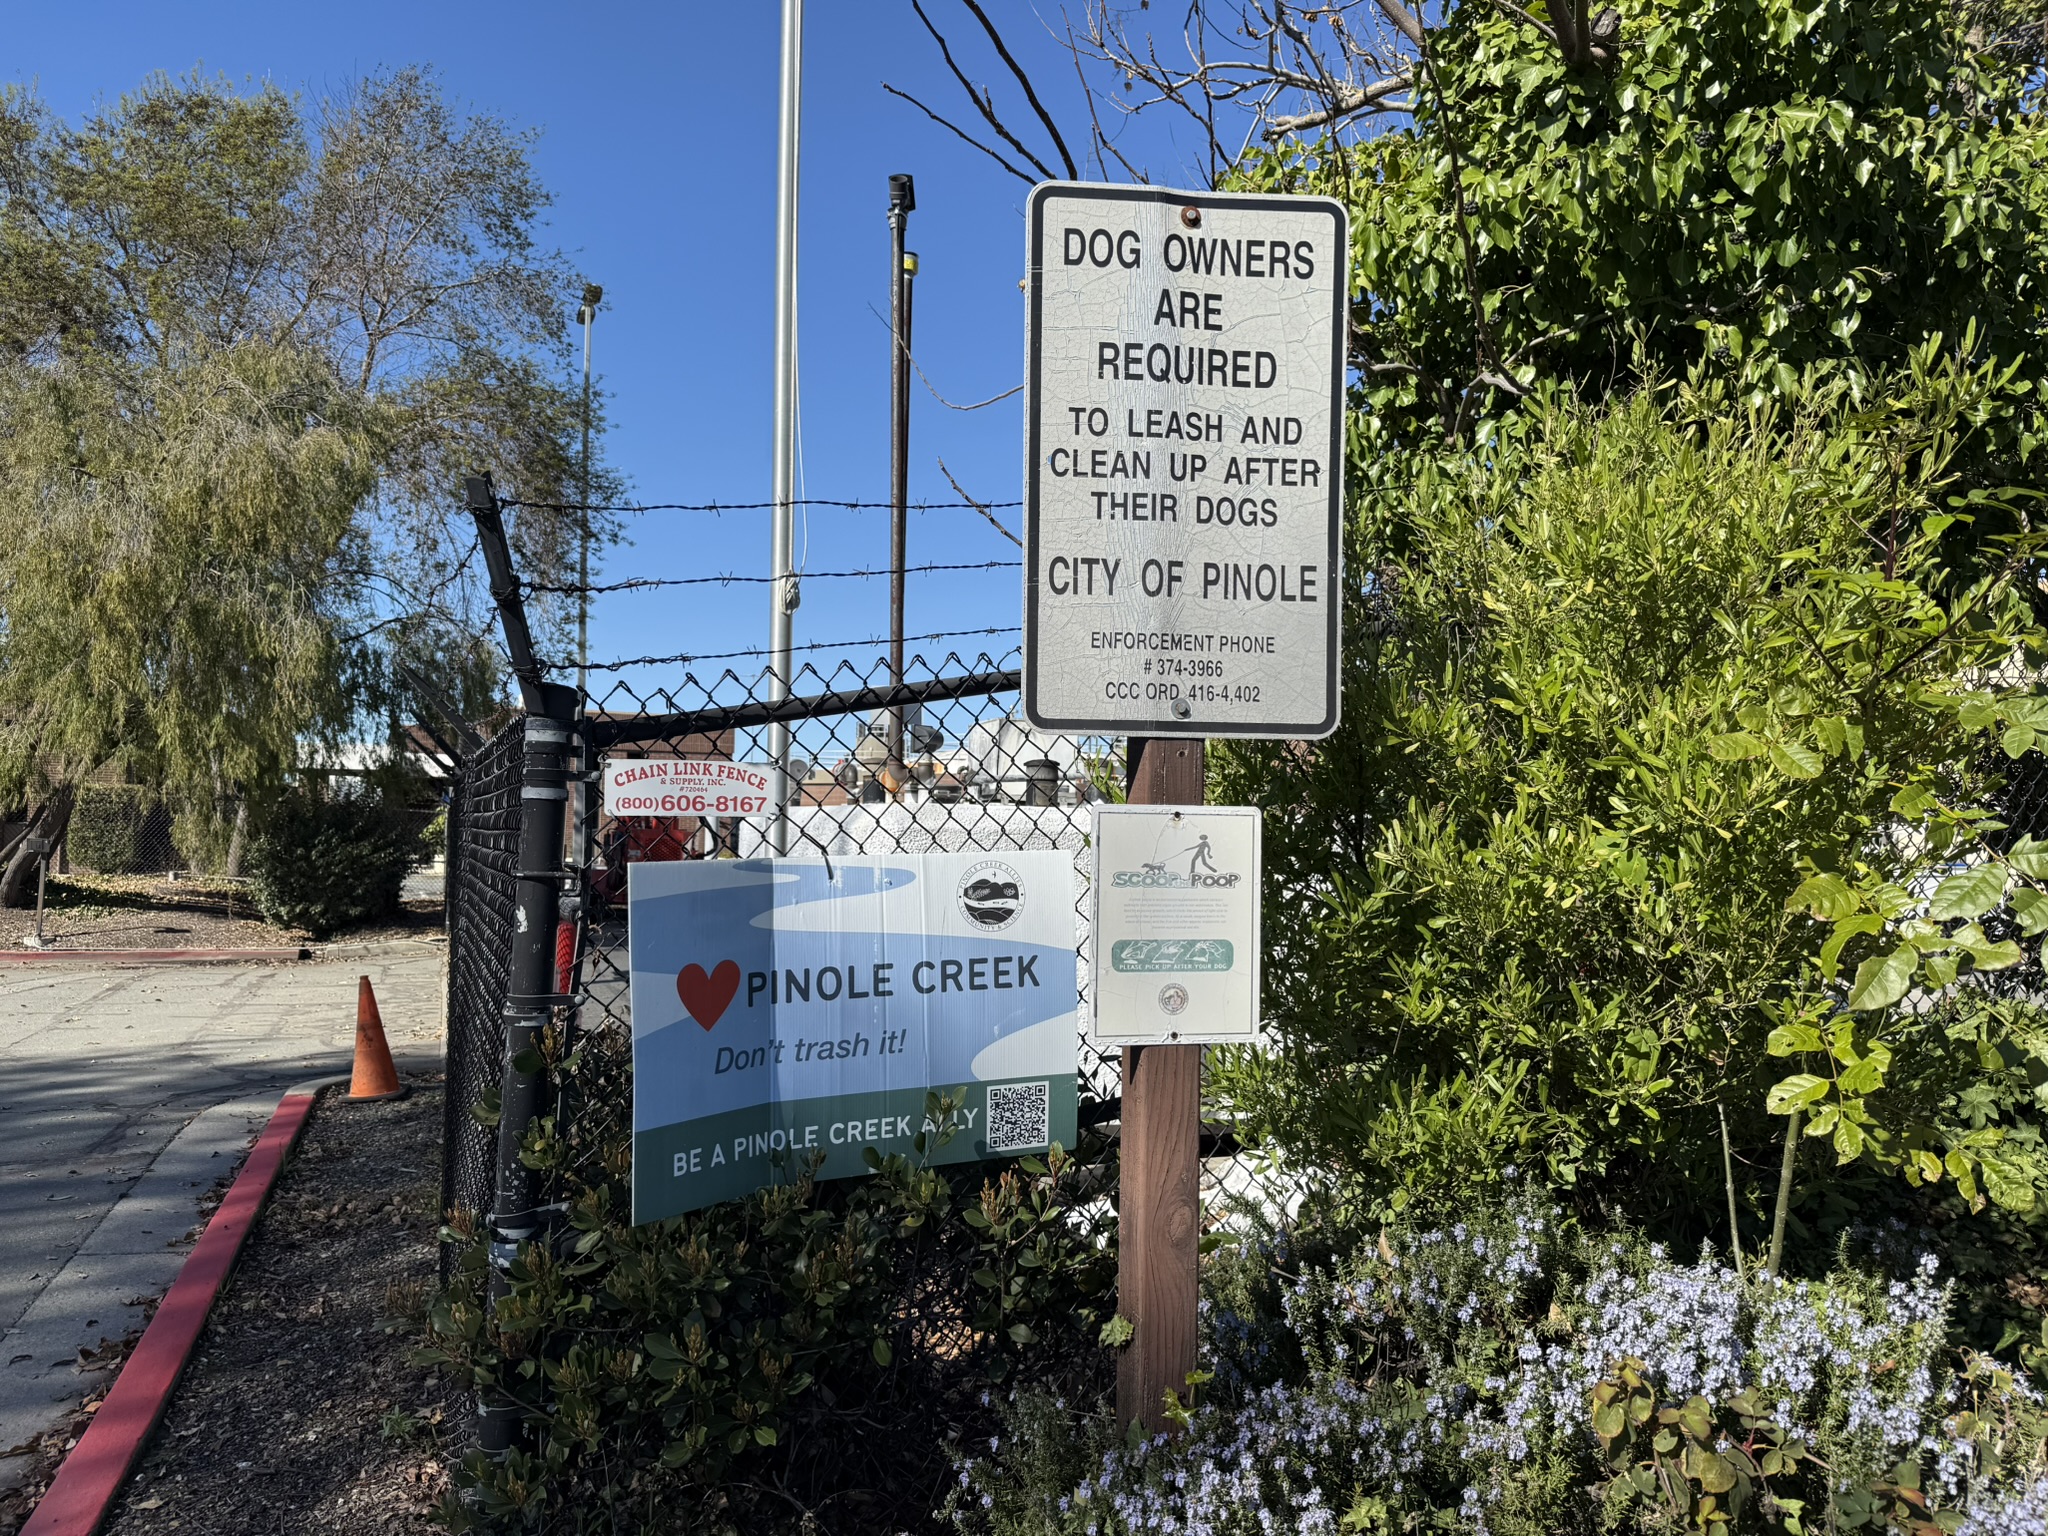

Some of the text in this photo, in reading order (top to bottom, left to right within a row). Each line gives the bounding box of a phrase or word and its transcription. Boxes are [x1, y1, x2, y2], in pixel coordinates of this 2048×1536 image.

[1063, 228, 1315, 280] DOG OWNERS
[1153, 288, 1223, 331] ARE
[1098, 341, 1278, 389] REQUIRED
[1068, 406, 1303, 445] TO LEASH AND
[1050, 448, 1320, 487] CLEAN UP AFTER
[1091, 491, 1278, 527] THEIR DOGS
[1050, 556, 1318, 602] CITY OF PINOLE
[1091, 632, 1276, 653] ENFORCEMENT PHONE
[1157, 659, 1223, 677] 374-3966
[1105, 682, 1140, 700] CCC
[1188, 684, 1261, 705] 416-4,402
[614, 762, 768, 791] CHAIN LINK FENCE
[707, 778, 726, 786] INC.
[960, 866, 979, 890] PINOLE
[1005, 867, 1022, 888] ALLIES
[1113, 872, 1180, 887] SCOOP
[1190, 873, 1240, 887] POOP
[960, 905, 995, 930] COMMUNITY
[1003, 904, 1023, 926] SCIENCE
[746, 954, 1040, 1008] PINOLE CREEK
[714, 1028, 907, 1075] Don't trash it!
[673, 1148, 702, 1177] BE
[710, 1144, 726, 1168] A
[734, 1125, 819, 1162] PINOLE
[829, 1115, 912, 1145] CREEK
